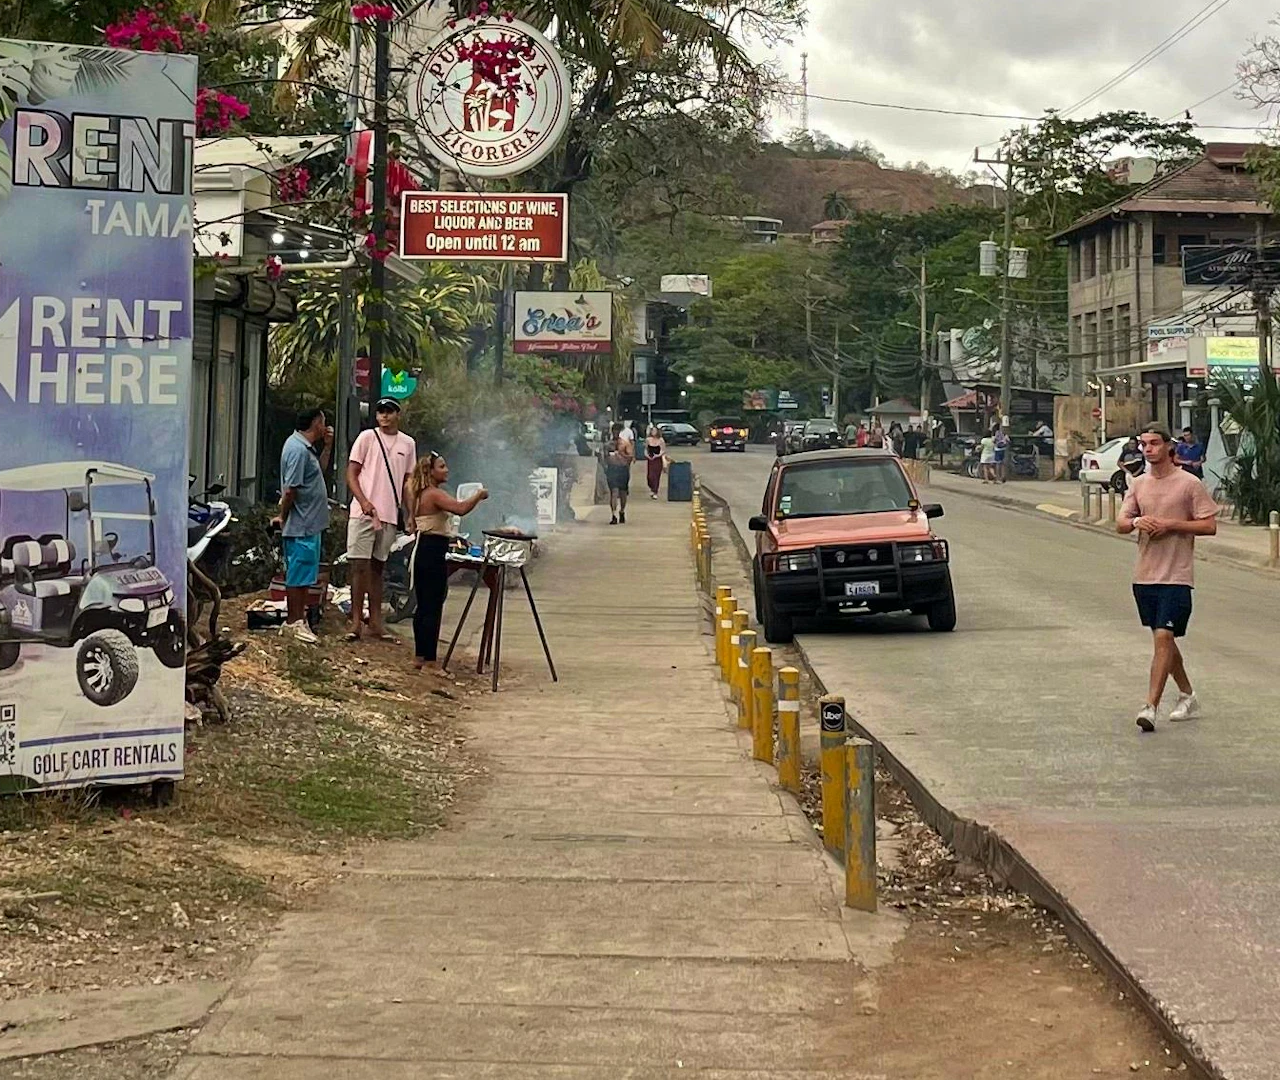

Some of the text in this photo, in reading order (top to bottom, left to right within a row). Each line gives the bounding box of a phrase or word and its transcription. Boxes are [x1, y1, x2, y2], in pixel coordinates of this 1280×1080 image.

[440, 127, 540, 161] LICORERA
[410, 199, 558, 217] BEST SELECTIONS OF WINE,
[434, 216, 533, 231] LIQUOR AND BEER
[426, 233, 541, 253] Open until 12 am
[31, 296, 182, 350] RENT
[28, 353, 178, 406] HERE
[33, 742, 177, 775] GOLF CART RENTALS
